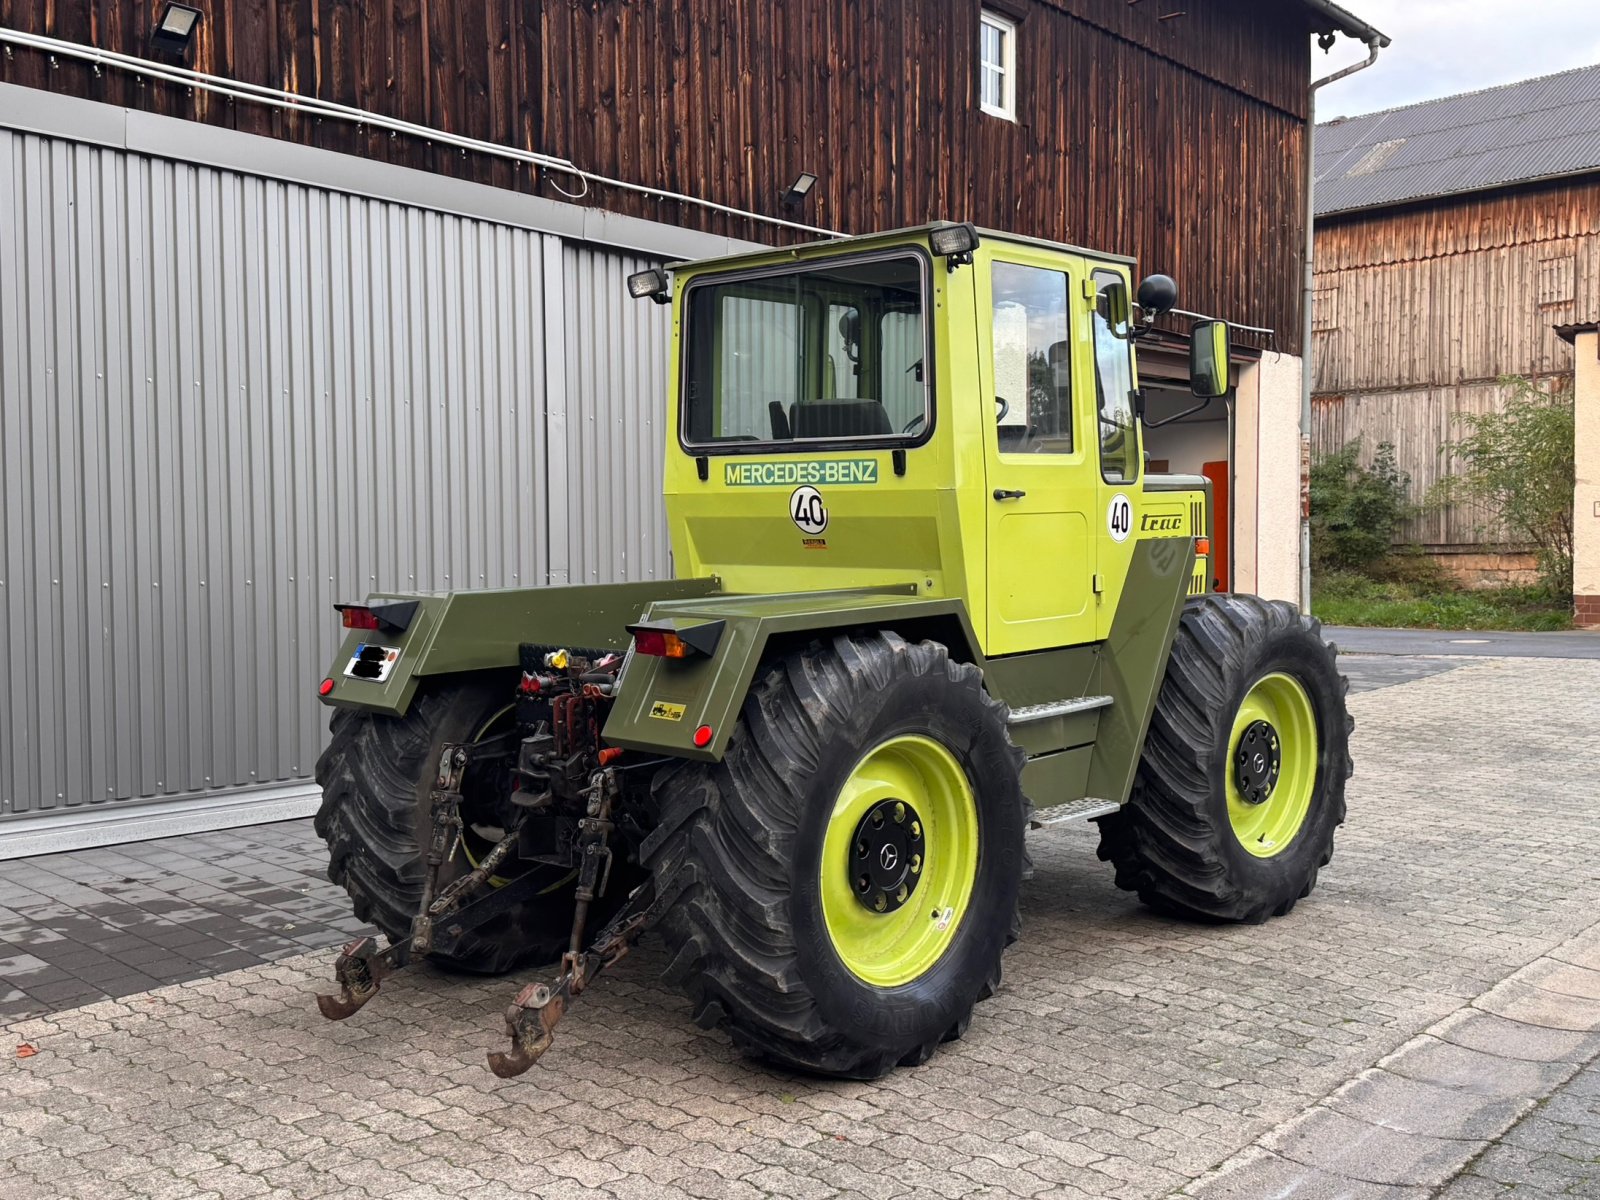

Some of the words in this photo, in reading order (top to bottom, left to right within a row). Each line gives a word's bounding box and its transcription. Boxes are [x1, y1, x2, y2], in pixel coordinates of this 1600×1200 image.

[726, 461, 876, 484] MERCEDES-BENZ
[795, 494, 825, 526] 40
[1111, 502, 1129, 533] 40
[1140, 514, 1183, 531] trac
